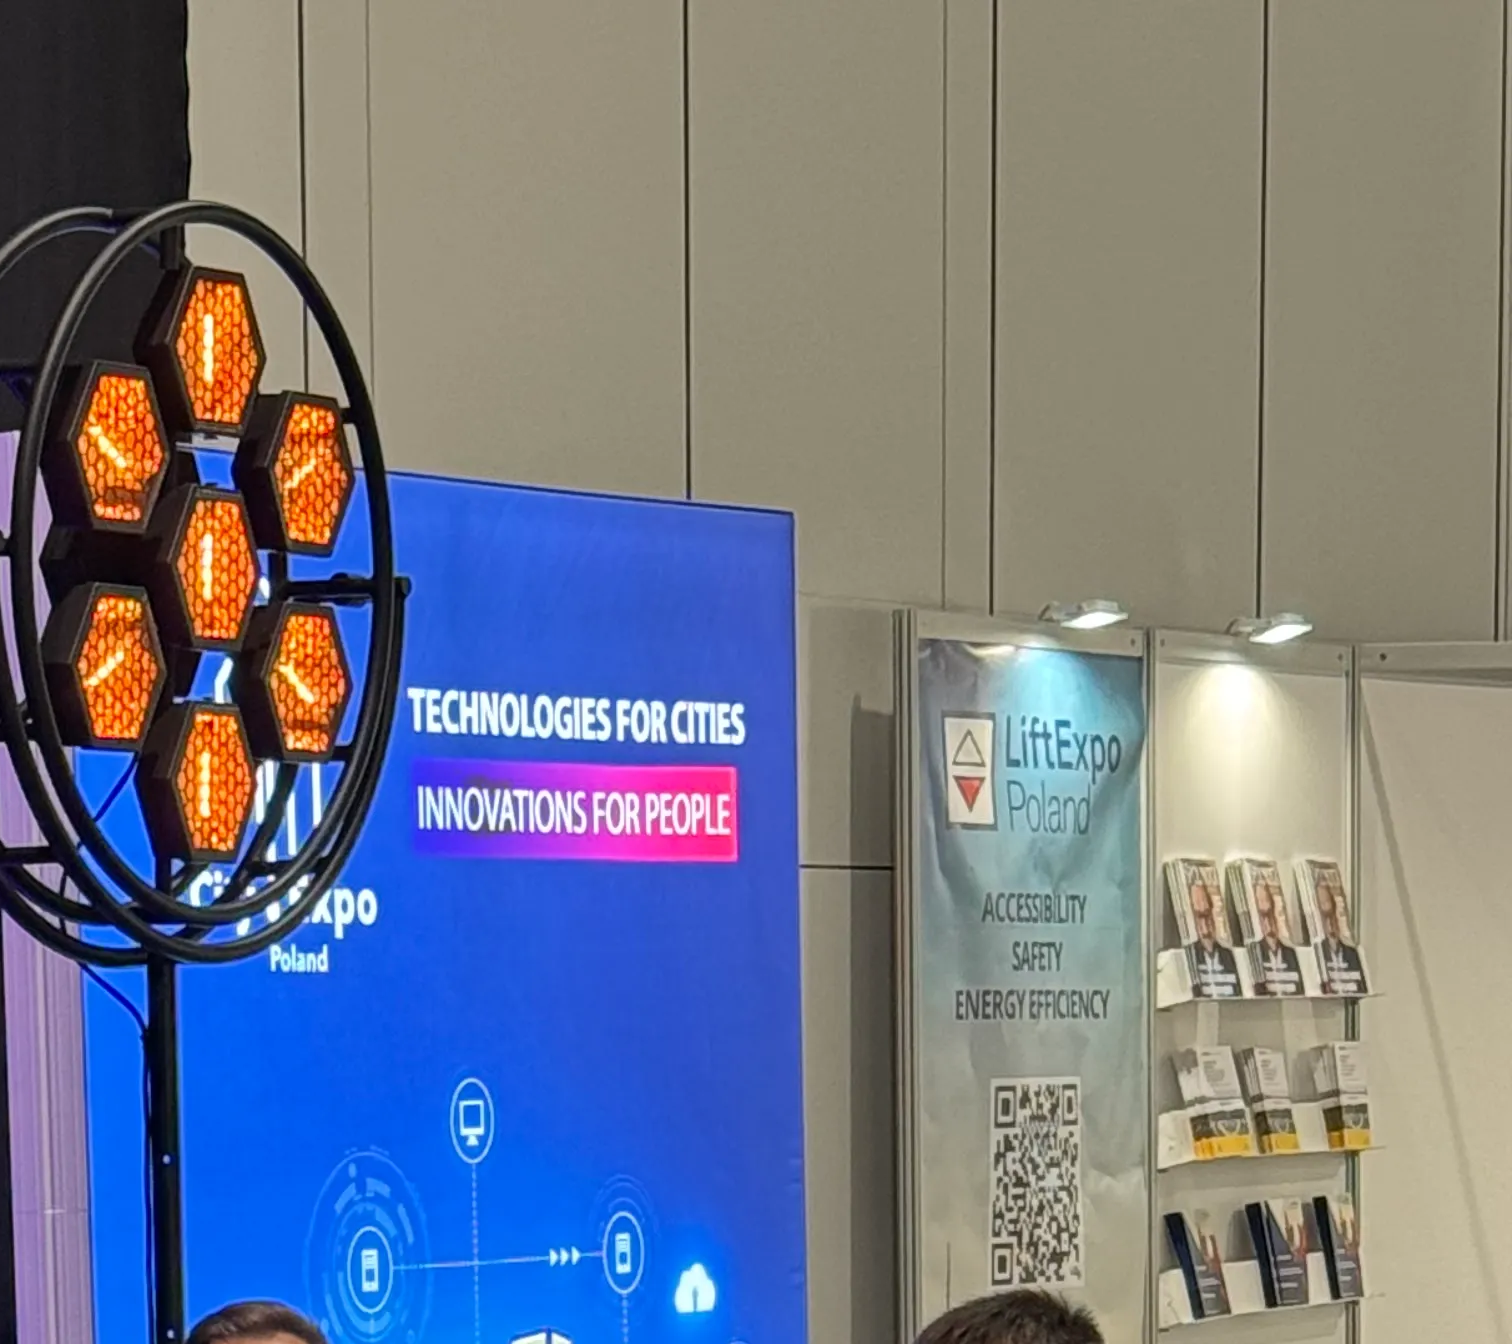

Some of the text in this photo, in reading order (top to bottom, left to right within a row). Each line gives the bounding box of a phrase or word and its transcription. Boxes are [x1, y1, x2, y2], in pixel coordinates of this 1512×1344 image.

[407, 688, 745, 745] TECHNOLOGIES FOR CITIES
[1004, 714, 1121, 784] LiftExpo
[417, 785, 731, 837] INNOVATIONS FOR PEOPLE
[1007, 780, 1090, 835] Poland
[981, 891, 1087, 924] ACCESSIBILITY
[269, 943, 329, 974] Poland
[1011, 940, 1064, 972] SAFETY
[955, 988, 1110, 1021] ENERGY EFFICIENCY
